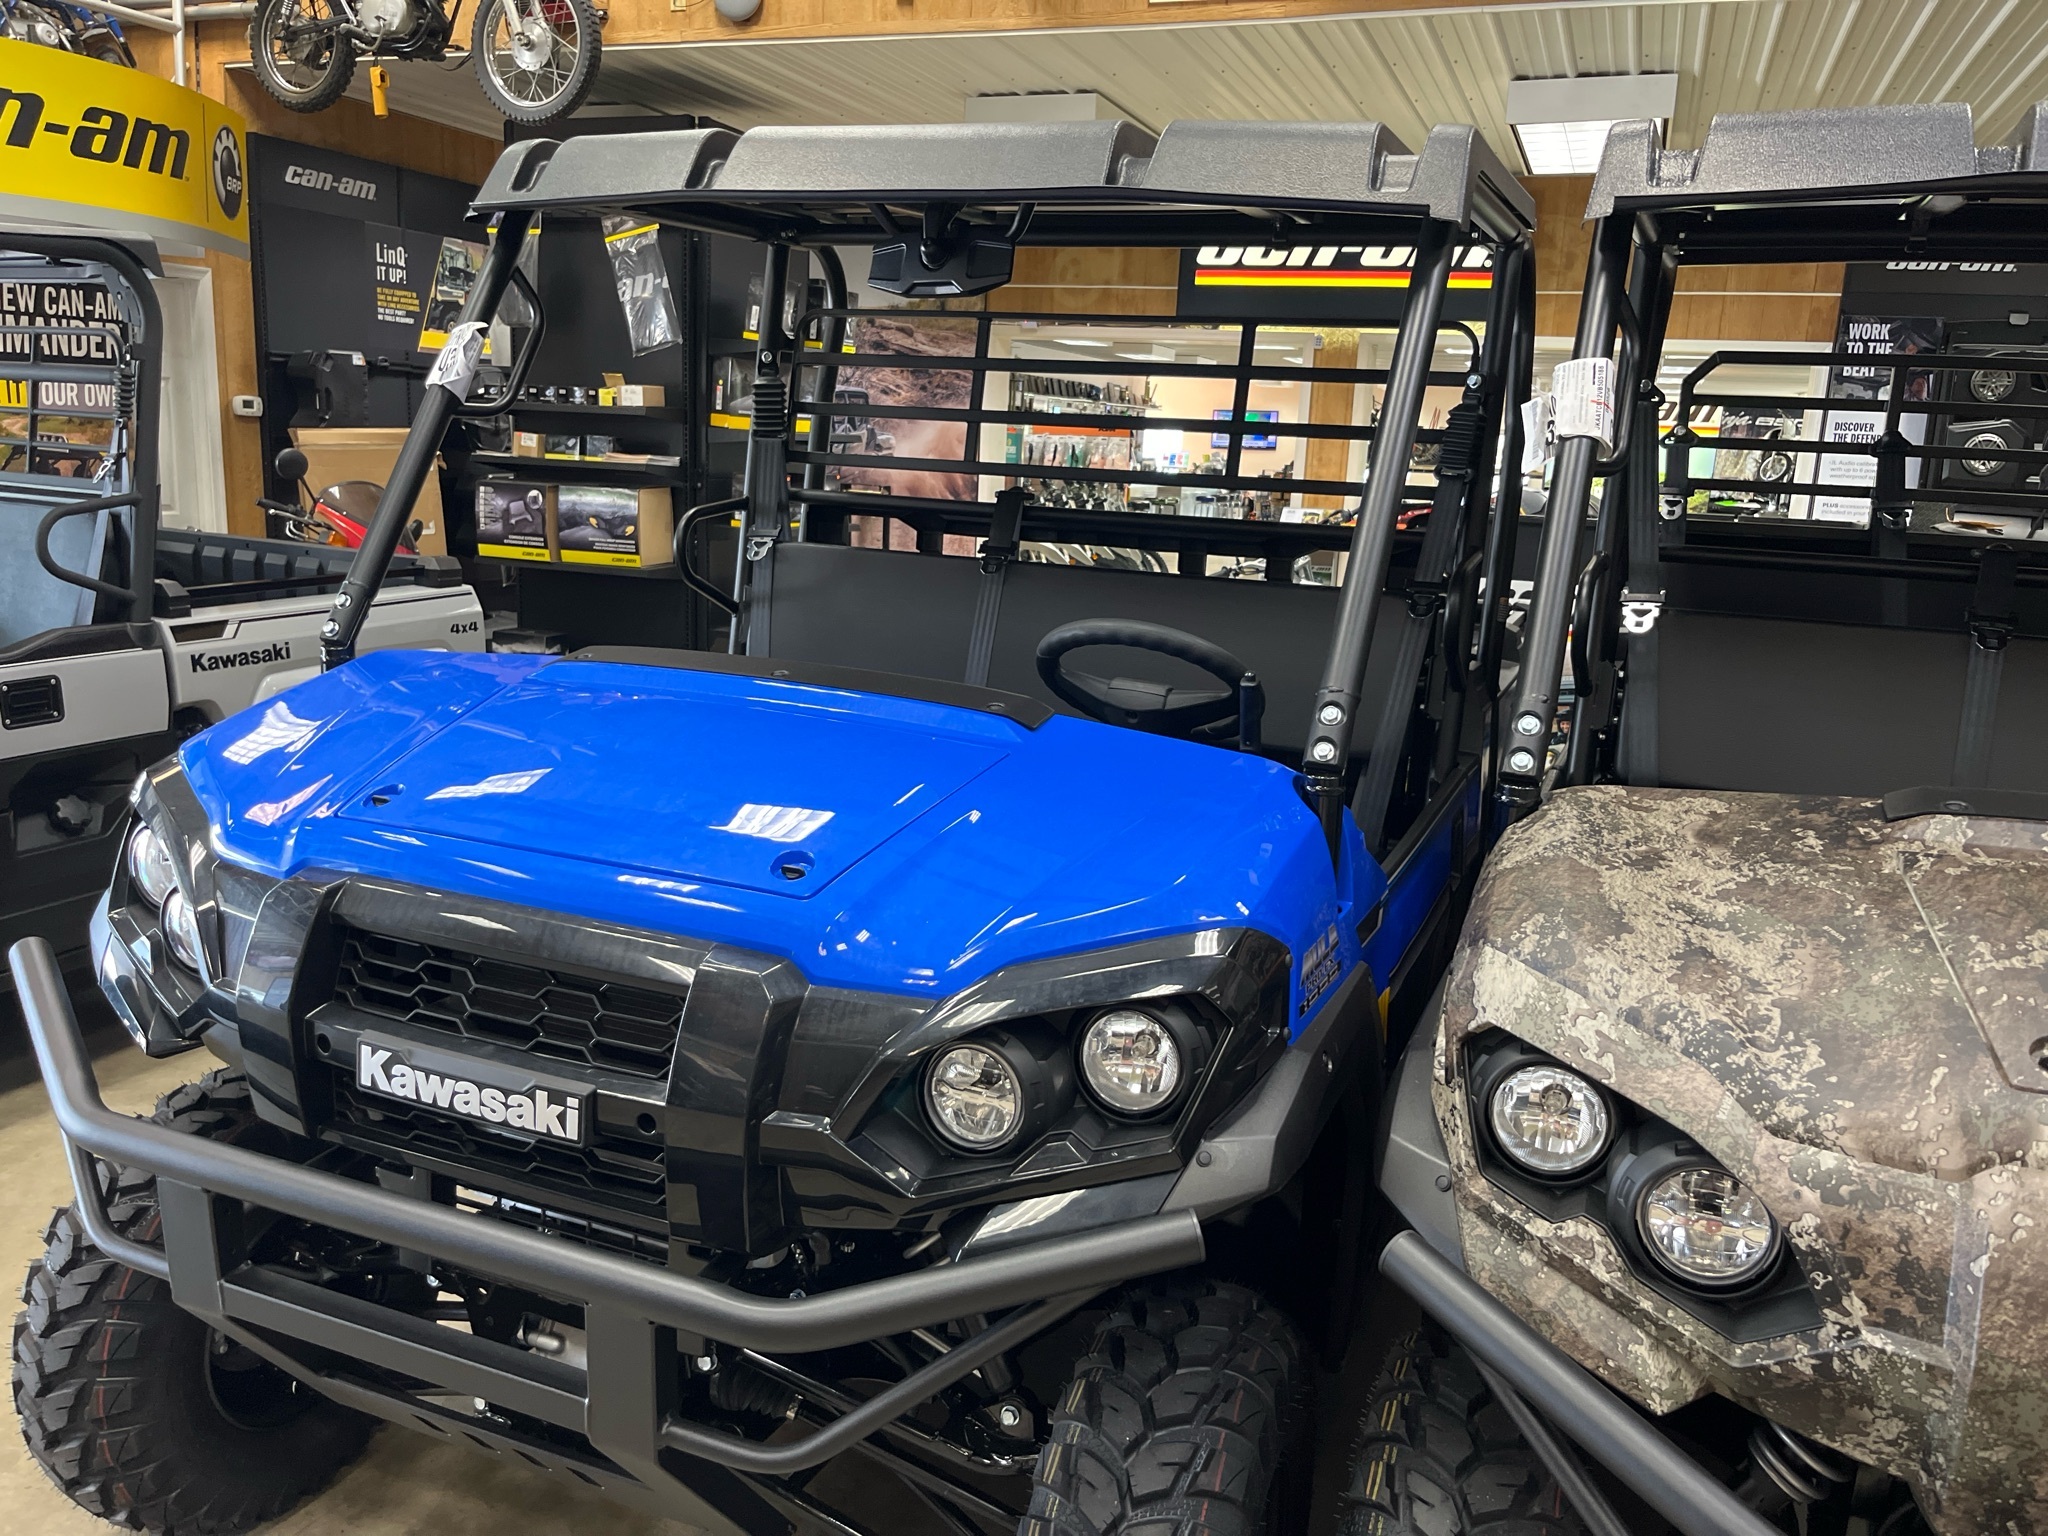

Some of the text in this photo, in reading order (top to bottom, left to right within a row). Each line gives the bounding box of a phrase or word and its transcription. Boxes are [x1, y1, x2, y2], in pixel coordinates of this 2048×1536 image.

[226, 175, 242, 194] BRP
[285, 165, 376, 200] can-am
[377, 265, 407, 284] IT UP!
[0, 283, 36, 313] EW
[1849, 323, 1891, 340] WORK
[1847, 342, 1894, 355] TO THE
[39, 382, 79, 406] OUR
[1834, 422, 1875, 432] DISCOVER
[1833, 433, 1848, 443] THE
[450, 621, 479, 634] 4x4
[190, 641, 291, 673] Kawasaki
[361, 1044, 579, 1141] Kawasaki
